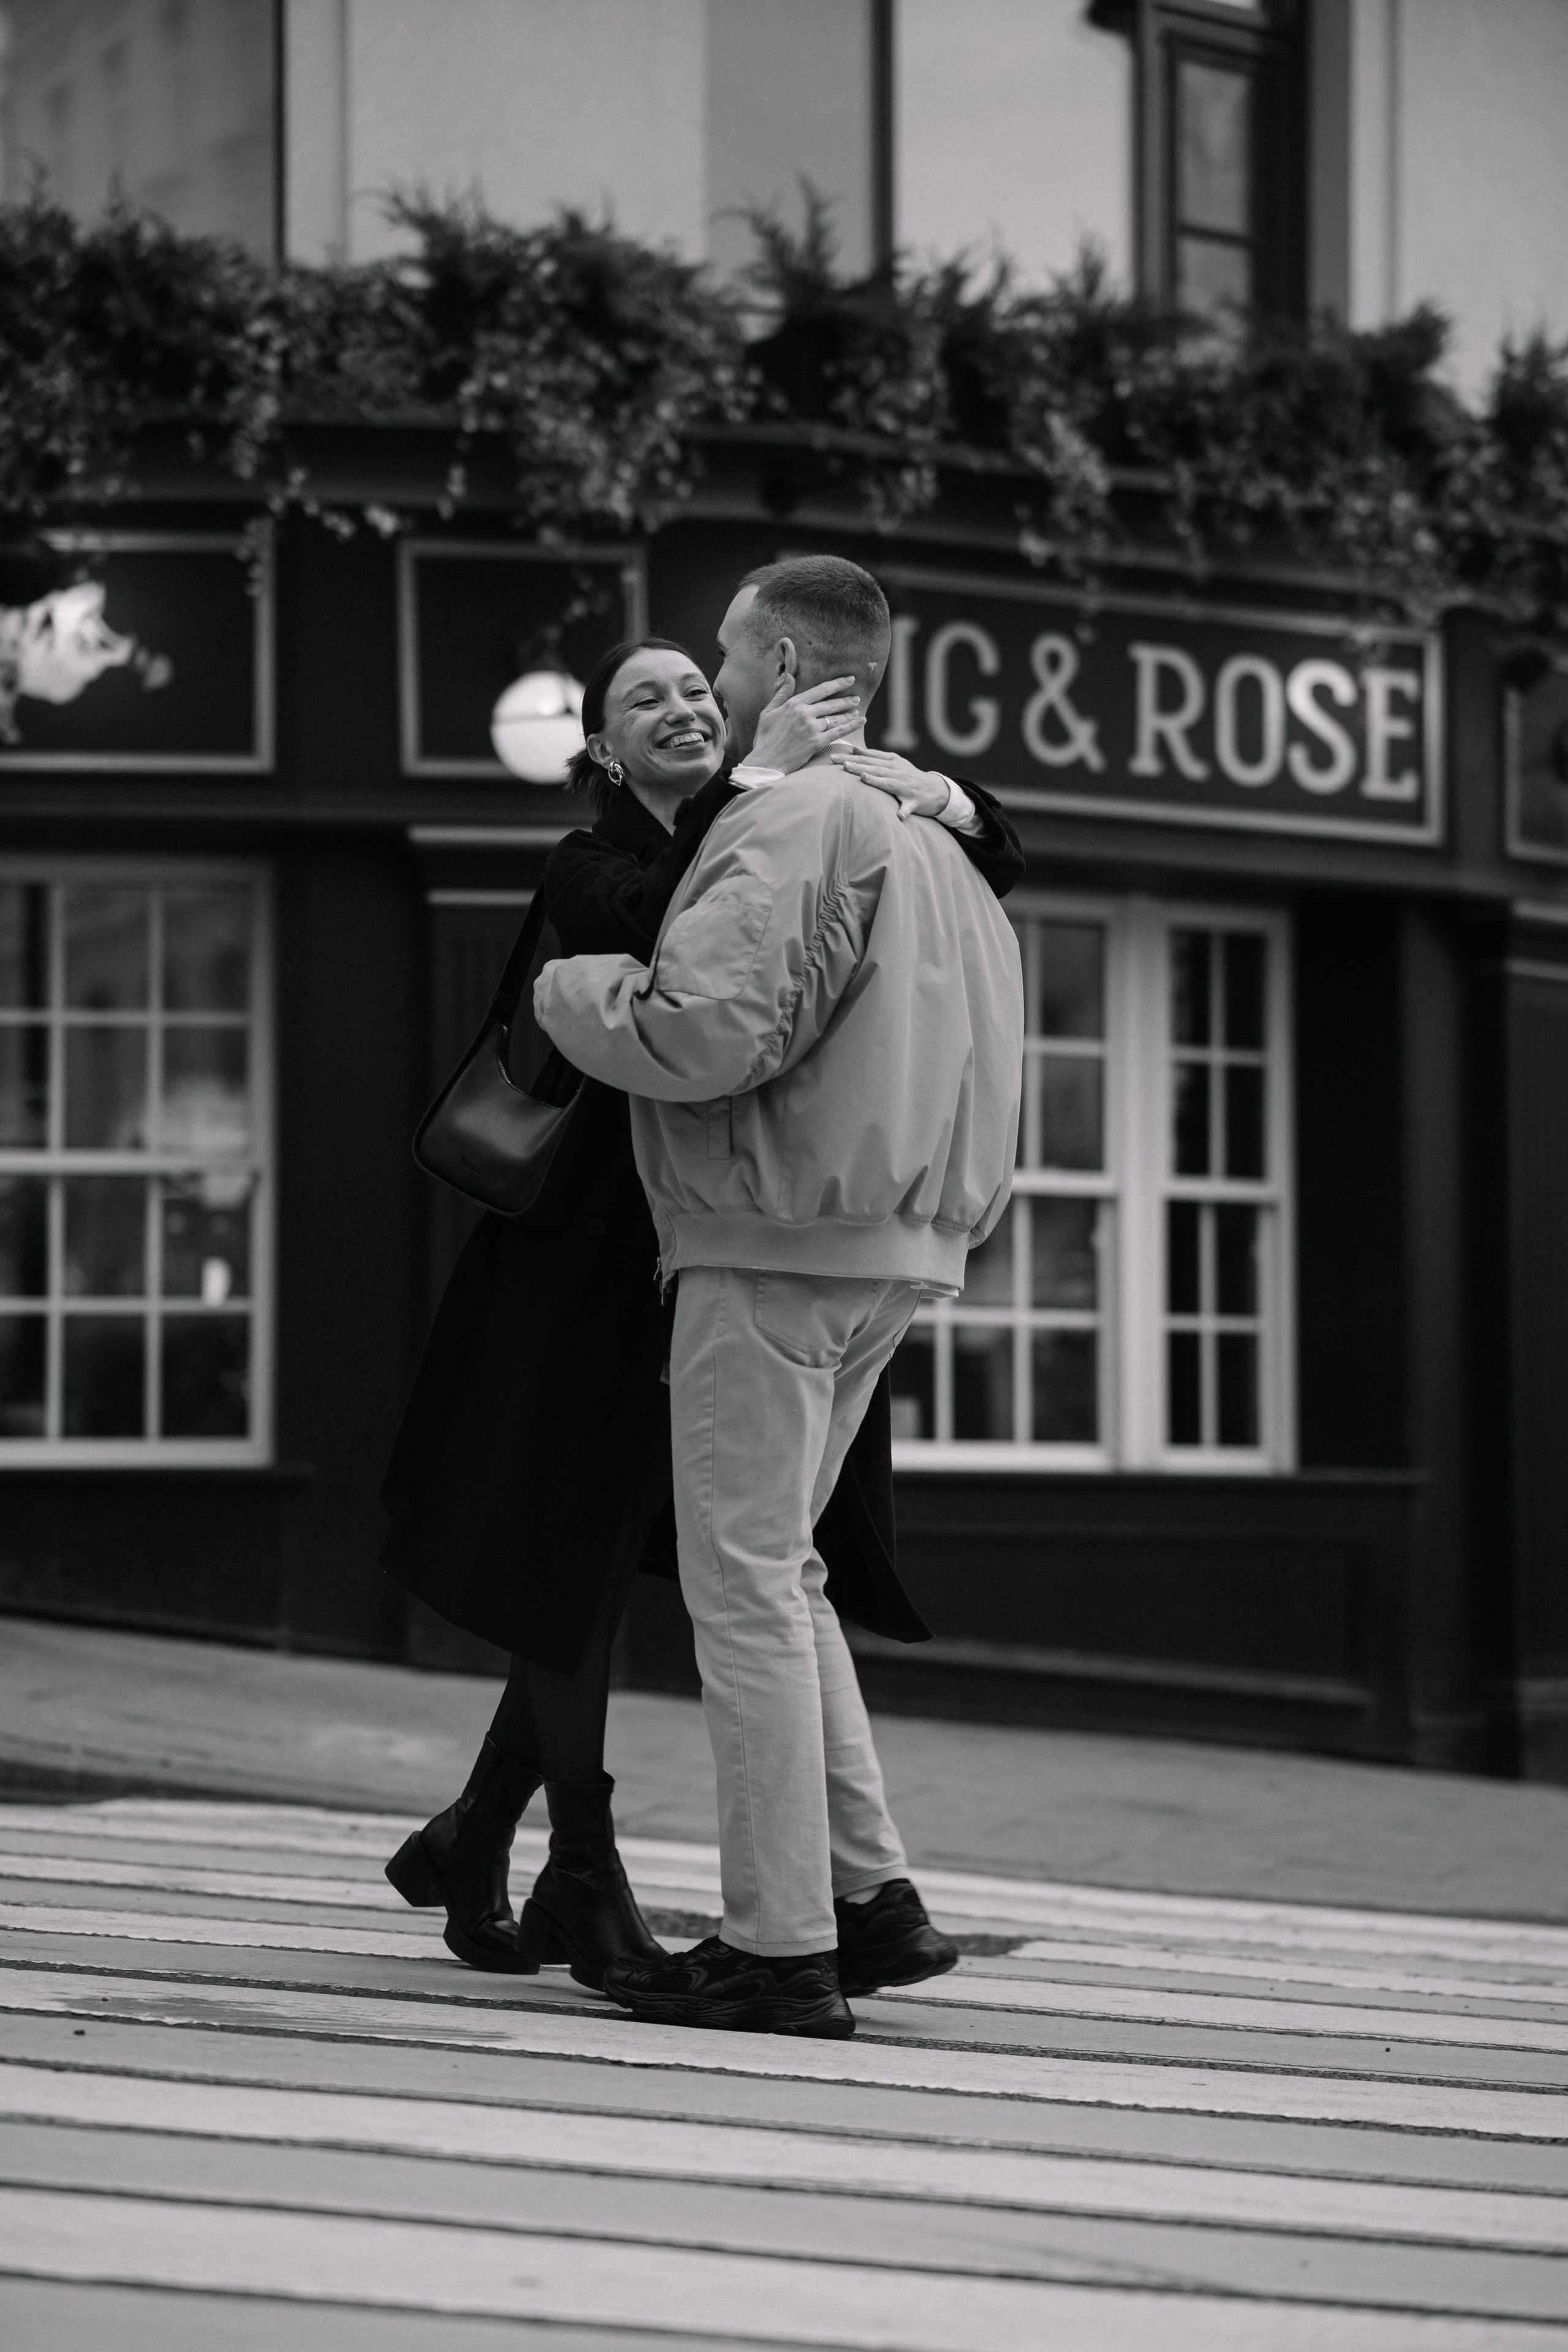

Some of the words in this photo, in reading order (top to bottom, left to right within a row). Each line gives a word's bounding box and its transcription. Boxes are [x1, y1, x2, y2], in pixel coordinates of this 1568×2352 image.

[882, 616, 1001, 756] IG
[1021, 631, 1104, 772] &
[1128, 641, 1420, 802] ROSE
